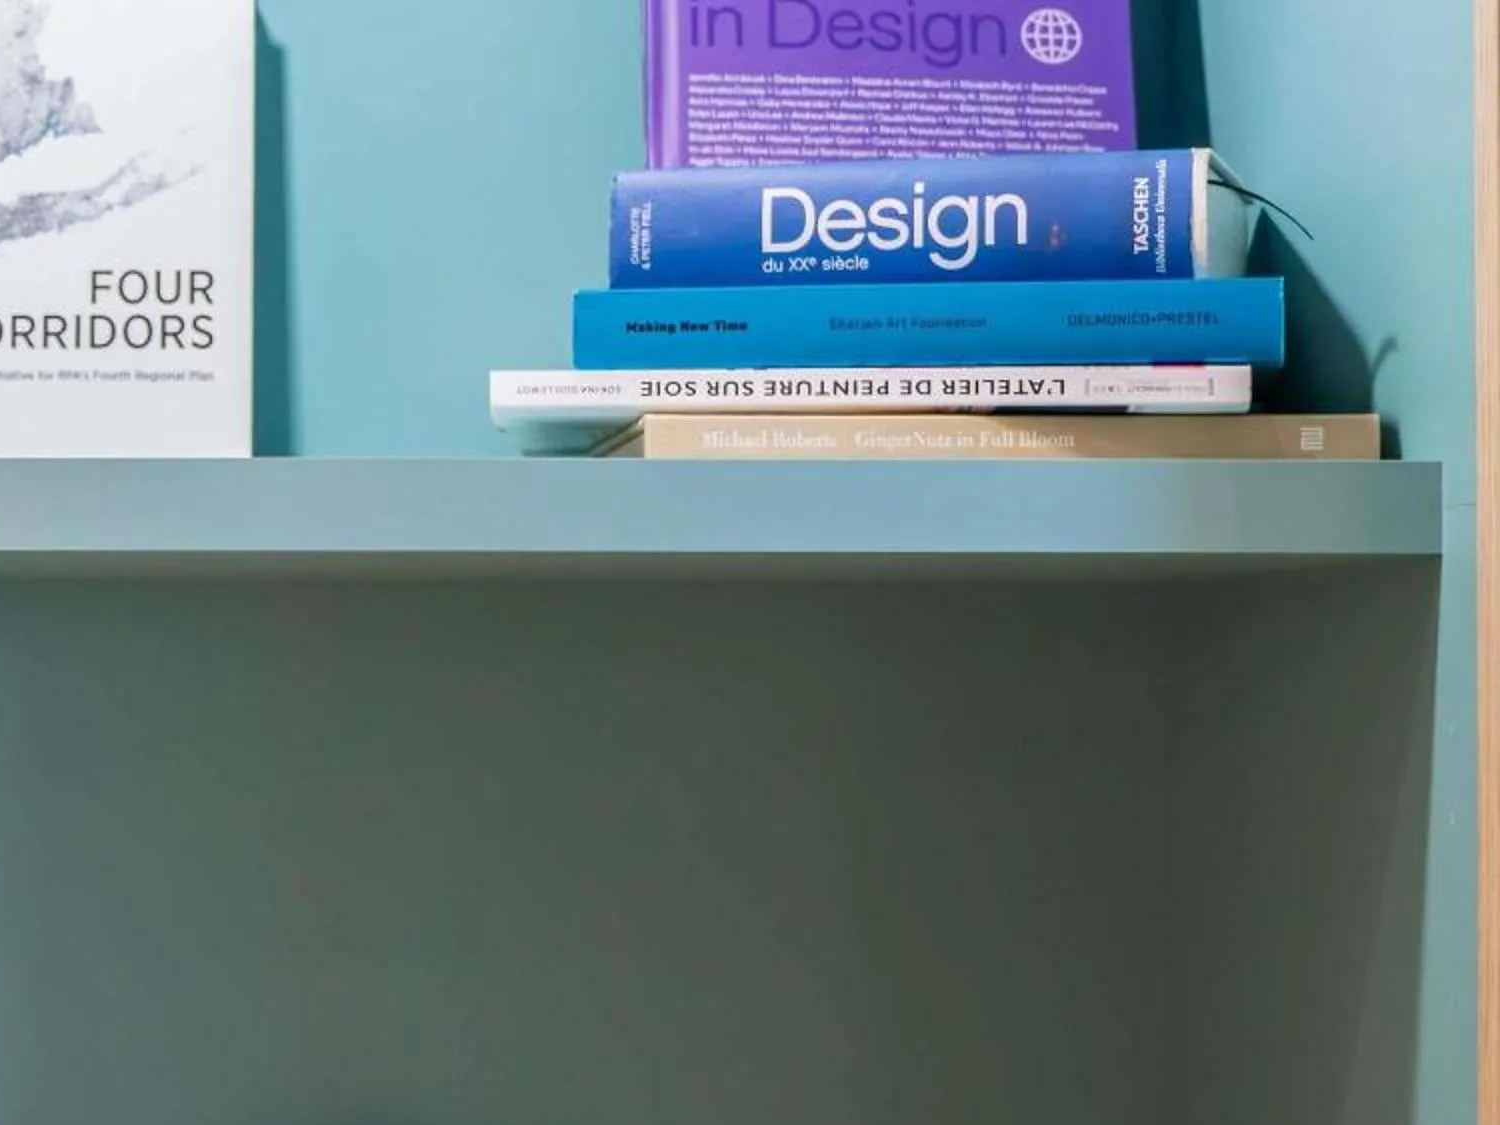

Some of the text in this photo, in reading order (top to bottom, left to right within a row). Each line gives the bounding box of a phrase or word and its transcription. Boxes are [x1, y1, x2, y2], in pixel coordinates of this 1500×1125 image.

[690, 0, 1007, 68] in Design
[1133, 177, 1149, 255] TASCHEN
[760, 181, 1028, 271] Design
[762, 257, 783, 272] du
[821, 254, 869, 271] siècle
[91, 270, 214, 304] FOUR
[626, 320, 747, 334] Making New Time
[639, 380, 697, 397] SOIE
[706, 379, 755, 397] SUR
[763, 379, 891, 397] PEINTURE
[899, 379, 932, 396] DE
[938, 378, 1066, 396] L'ATELIER
[701, 429, 838, 449] Michael Roberts
[957, 429, 974, 448] in
[980, 429, 1014, 448] Full
[1018, 429, 1076, 449] Bloom
